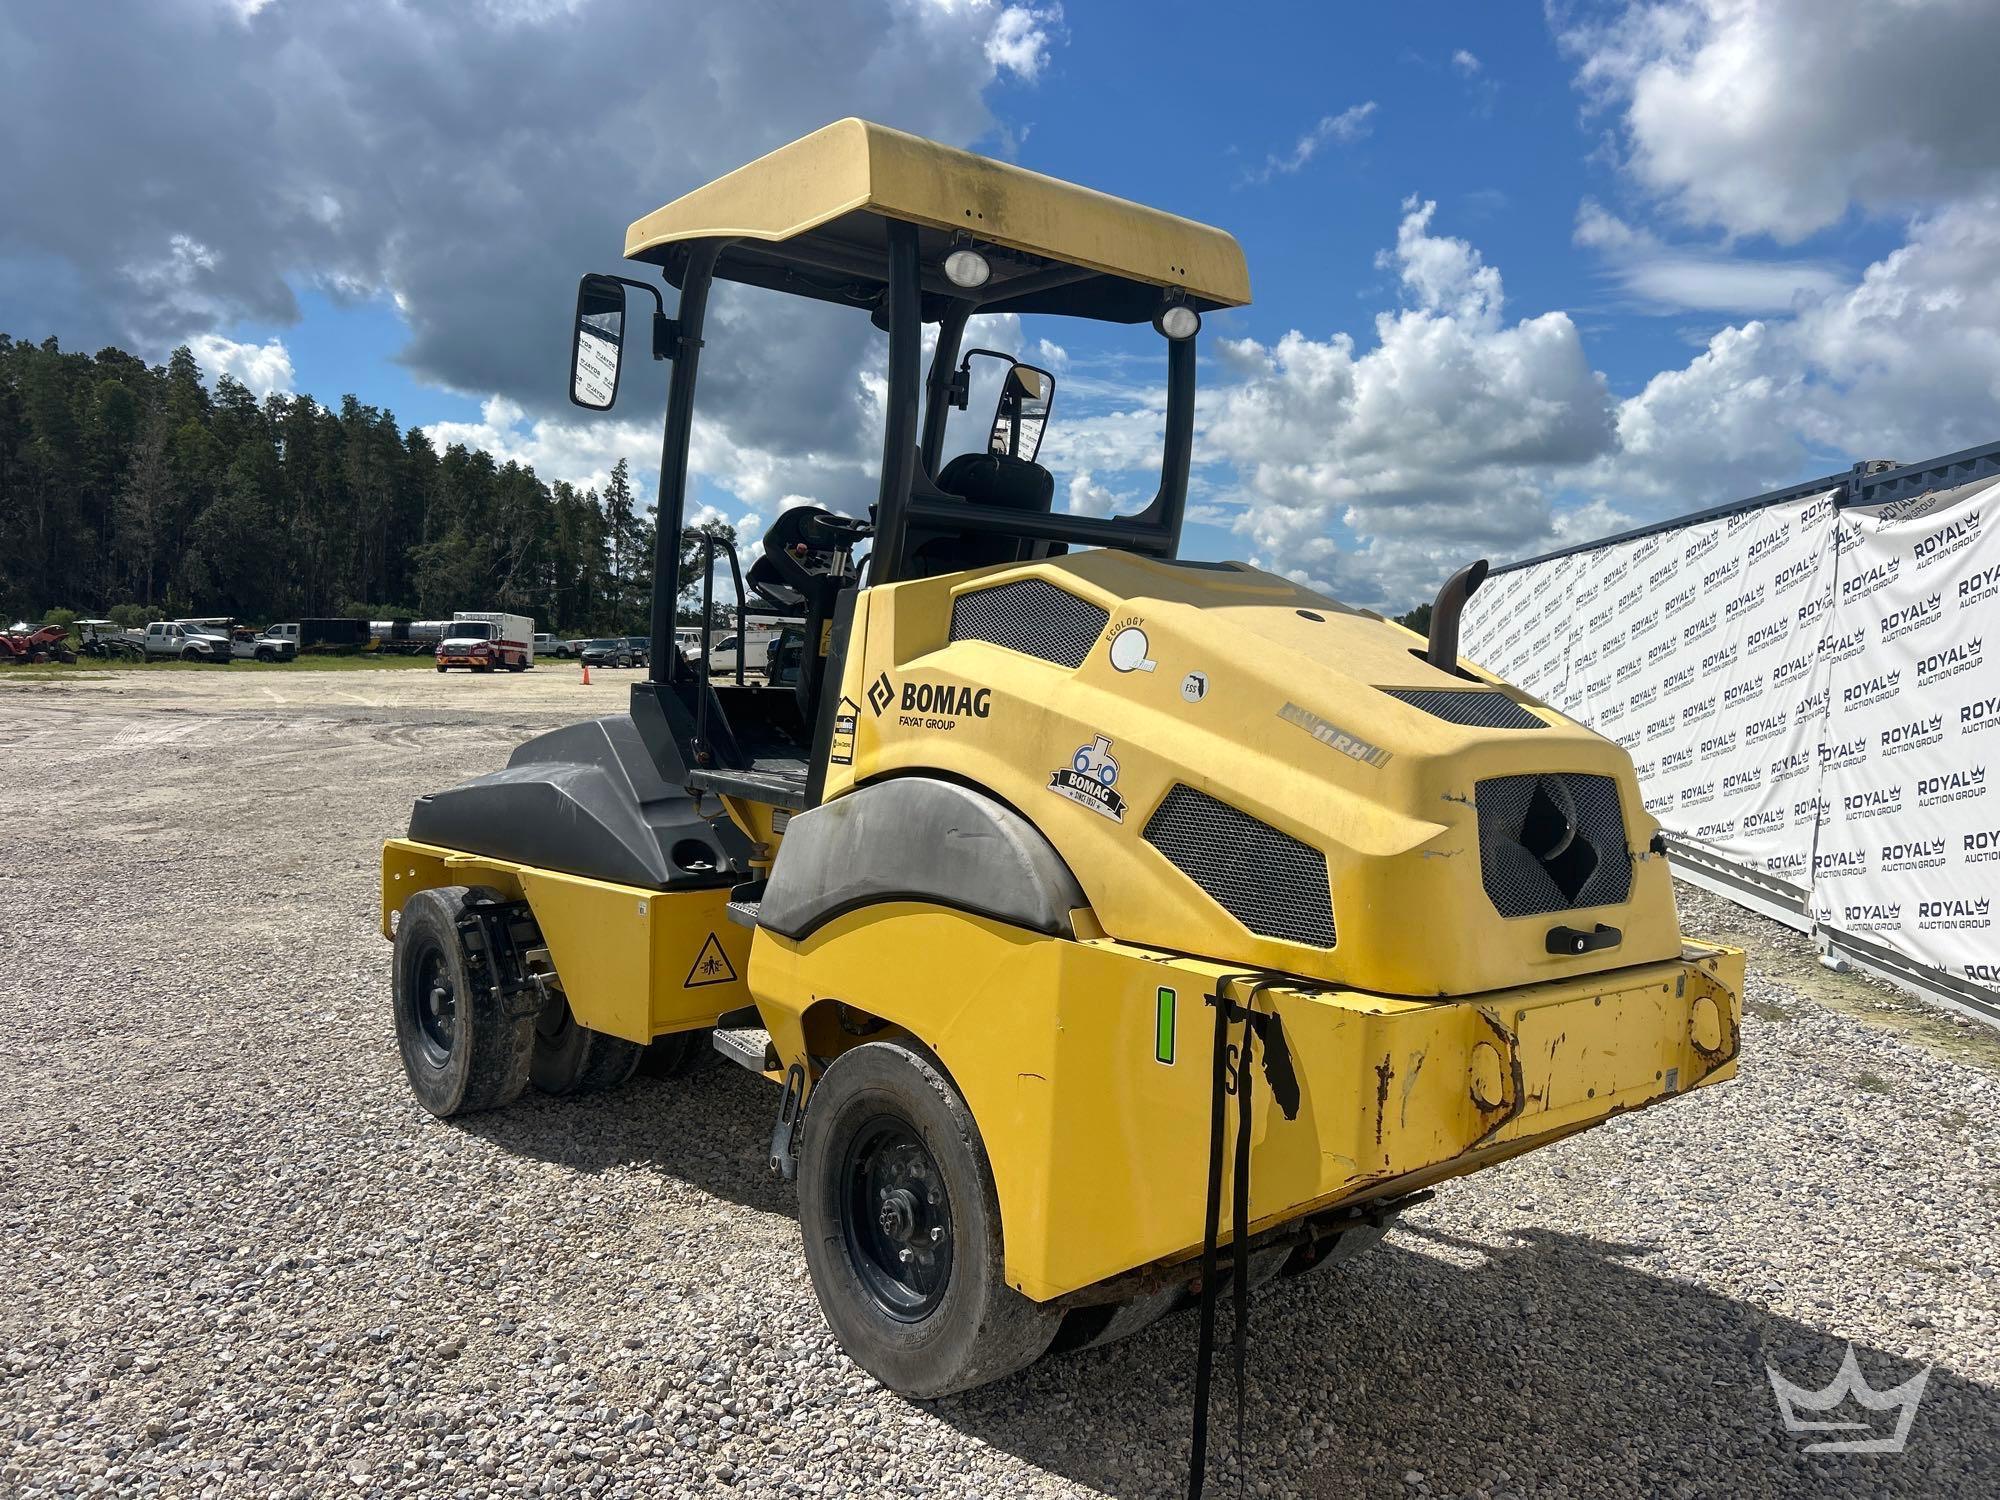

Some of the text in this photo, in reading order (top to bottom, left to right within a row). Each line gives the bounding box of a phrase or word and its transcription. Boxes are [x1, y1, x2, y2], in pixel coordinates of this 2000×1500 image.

[1800, 499, 1831, 524] ROYA
[1686, 535, 1711, 560] ROYAL
[1748, 529, 1781, 558] ROYAL
[1913, 522, 1966, 560] ROYAL
[1916, 530, 1981, 571] AUCTION GROUP
[1633, 541, 1653, 562] ROYAL
[1749, 536, 1790, 567] AUCTION GROUP
[1604, 566, 1622, 585] ROYAL
[1650, 565, 1671, 586] ROYAL
[1704, 562, 1731, 587] ROYAL
[1704, 569, 1739, 595] AUCTION GROUP
[1775, 558, 1809, 587] ROYAL
[1775, 566, 1818, 595] AUCTION GROUP
[1843, 565, 1886, 596] ROYAL
[1959, 564, 2000, 598] ROYA
[1619, 590, 1638, 608] ROYAL
[1843, 573, 1899, 606] AUCTION GROUP
[1959, 586, 1998, 609] AUCTION
[1665, 590, 1689, 612] ROYAL
[1726, 591, 1756, 615] ROYAL
[1590, 610, 1608, 628] ROYAL
[1631, 614, 1653, 634] ROYAL
[1881, 601, 1928, 633] ROYAL
[1106, 617, 1144, 641] ECOLOGY
[1684, 618, 1709, 639] ROYAL
[1748, 622, 1780, 647] ROYAL
[1882, 612, 1942, 644] AUCTION GROUP
[1602, 636, 1620, 652] ROYAL
[1648, 641, 1670, 659] ROYAL
[1748, 631, 1788, 656] AUCTION GROUP
[1843, 645, 1865, 660] GROUP
[1702, 650, 1729, 669] ROYAL
[1702, 656, 1738, 678] AUCTION GROUP
[1773, 656, 1808, 680] ROYAL
[1917, 645, 1967, 676] ROYAL
[1617, 662, 1637, 678] ROYAL
[1664, 671, 1687, 688] ROYAL
[1917, 657, 1983, 688] AUCTION GROUP
[1185, 684, 1197, 693] FSS
[1587, 678, 1607, 693] ROYAL
[1724, 681, 1754, 701] ROYAL
[1774, 675, 1797, 689] AUCTION
[1844, 676, 1887, 702] ROYAL
[901, 683, 991, 718] BOMAG
[1631, 690, 1651, 705] ROYAL
[1725, 690, 1763, 710] AUCTION GROUP
[1844, 687, 1900, 713] AUCTION GROUP
[1601, 705, 1619, 720] ROYAL
[1683, 702, 1708, 719] ROYAL
[1960, 698, 2000, 722] ROY
[899, 716, 955, 730] FAYAT GROUP
[1647, 719, 1669, 735] ROYAL
[1745, 716, 1778, 737] ROYAL
[1881, 720, 1928, 746] ROYAL
[1701, 734, 1728, 753] ROYAL
[1745, 727, 1786, 746] AUCTION GROUP
[1882, 734, 1943, 757] AUCTION GROUP
[1662, 751, 1686, 767] ROYAL
[1771, 754, 1801, 775] ROYAL
[1843, 755, 1866, 767] GROUP
[1069, 773, 1109, 801] BOMAG
[1723, 771, 1752, 789] ROYAL
[1724, 782, 1761, 797] AUCTION GROUP
[1918, 771, 1970, 796] ROYAL
[1645, 796, 1667, 809] ROYAL
[1681, 785, 1707, 801] ROYAL
[1845, 789, 1888, 810] ROYAL
[1918, 787, 1986, 807] AUCTION GROUP
[1794, 798, 1817, 816] ROYA
[1846, 804, 1901, 821] AUCTION GROUP
[1697, 823, 1727, 837] ROYAL
[1743, 813, 1775, 828] ROYAL
[1744, 823, 1784, 838] AUCTION GROUP
[1882, 841, 1931, 860] ROYAL
[1964, 831, 2000, 850] ROY
[1767, 855, 1801, 869] ROYAL
[1815, 852, 1855, 868] ROYAL
[1881, 858, 1946, 872] AUCTION GROUP
[1965, 851, 2000, 863] AUCTIO
[1815, 867, 1866, 879] AUCTION GROUP
[1845, 905, 1889, 920] ROYAL
[1919, 900, 1974, 917] ROYAL
[1846, 922, 1901, 931] AUCTION GROUP
[1918, 920, 1990, 929] AUCTION GROUP
[1964, 965, 2000, 980] ROY
